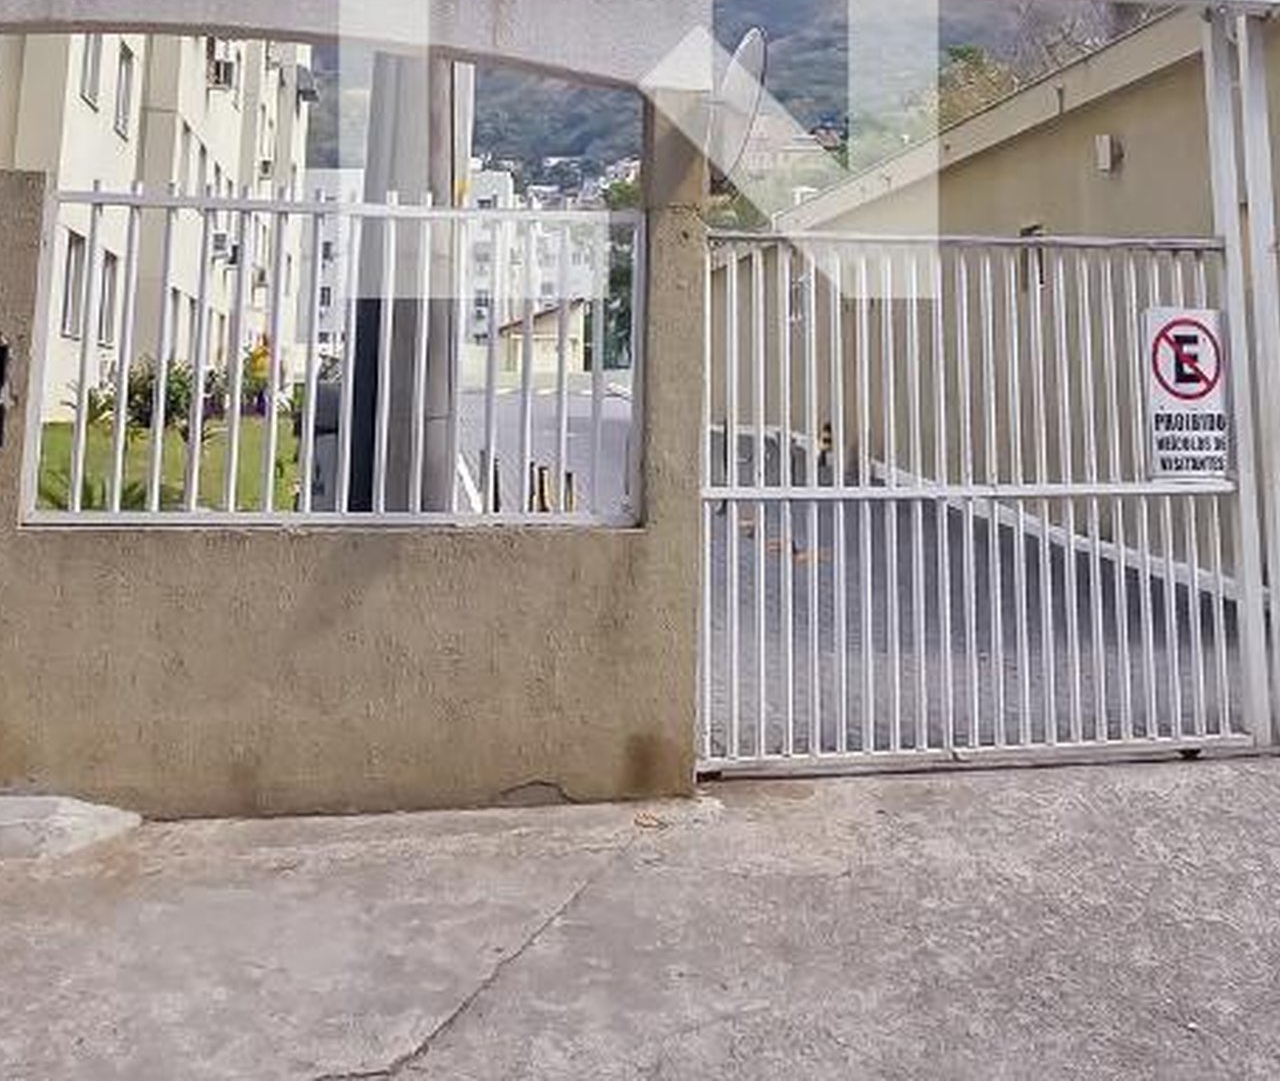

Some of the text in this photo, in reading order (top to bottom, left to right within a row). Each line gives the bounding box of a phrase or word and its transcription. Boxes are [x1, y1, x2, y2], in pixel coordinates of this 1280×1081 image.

[1174, 334, 1201, 384] E
[1154, 413, 1226, 431] PROIBIDO
[1160, 455, 1224, 471] VISITANTES
